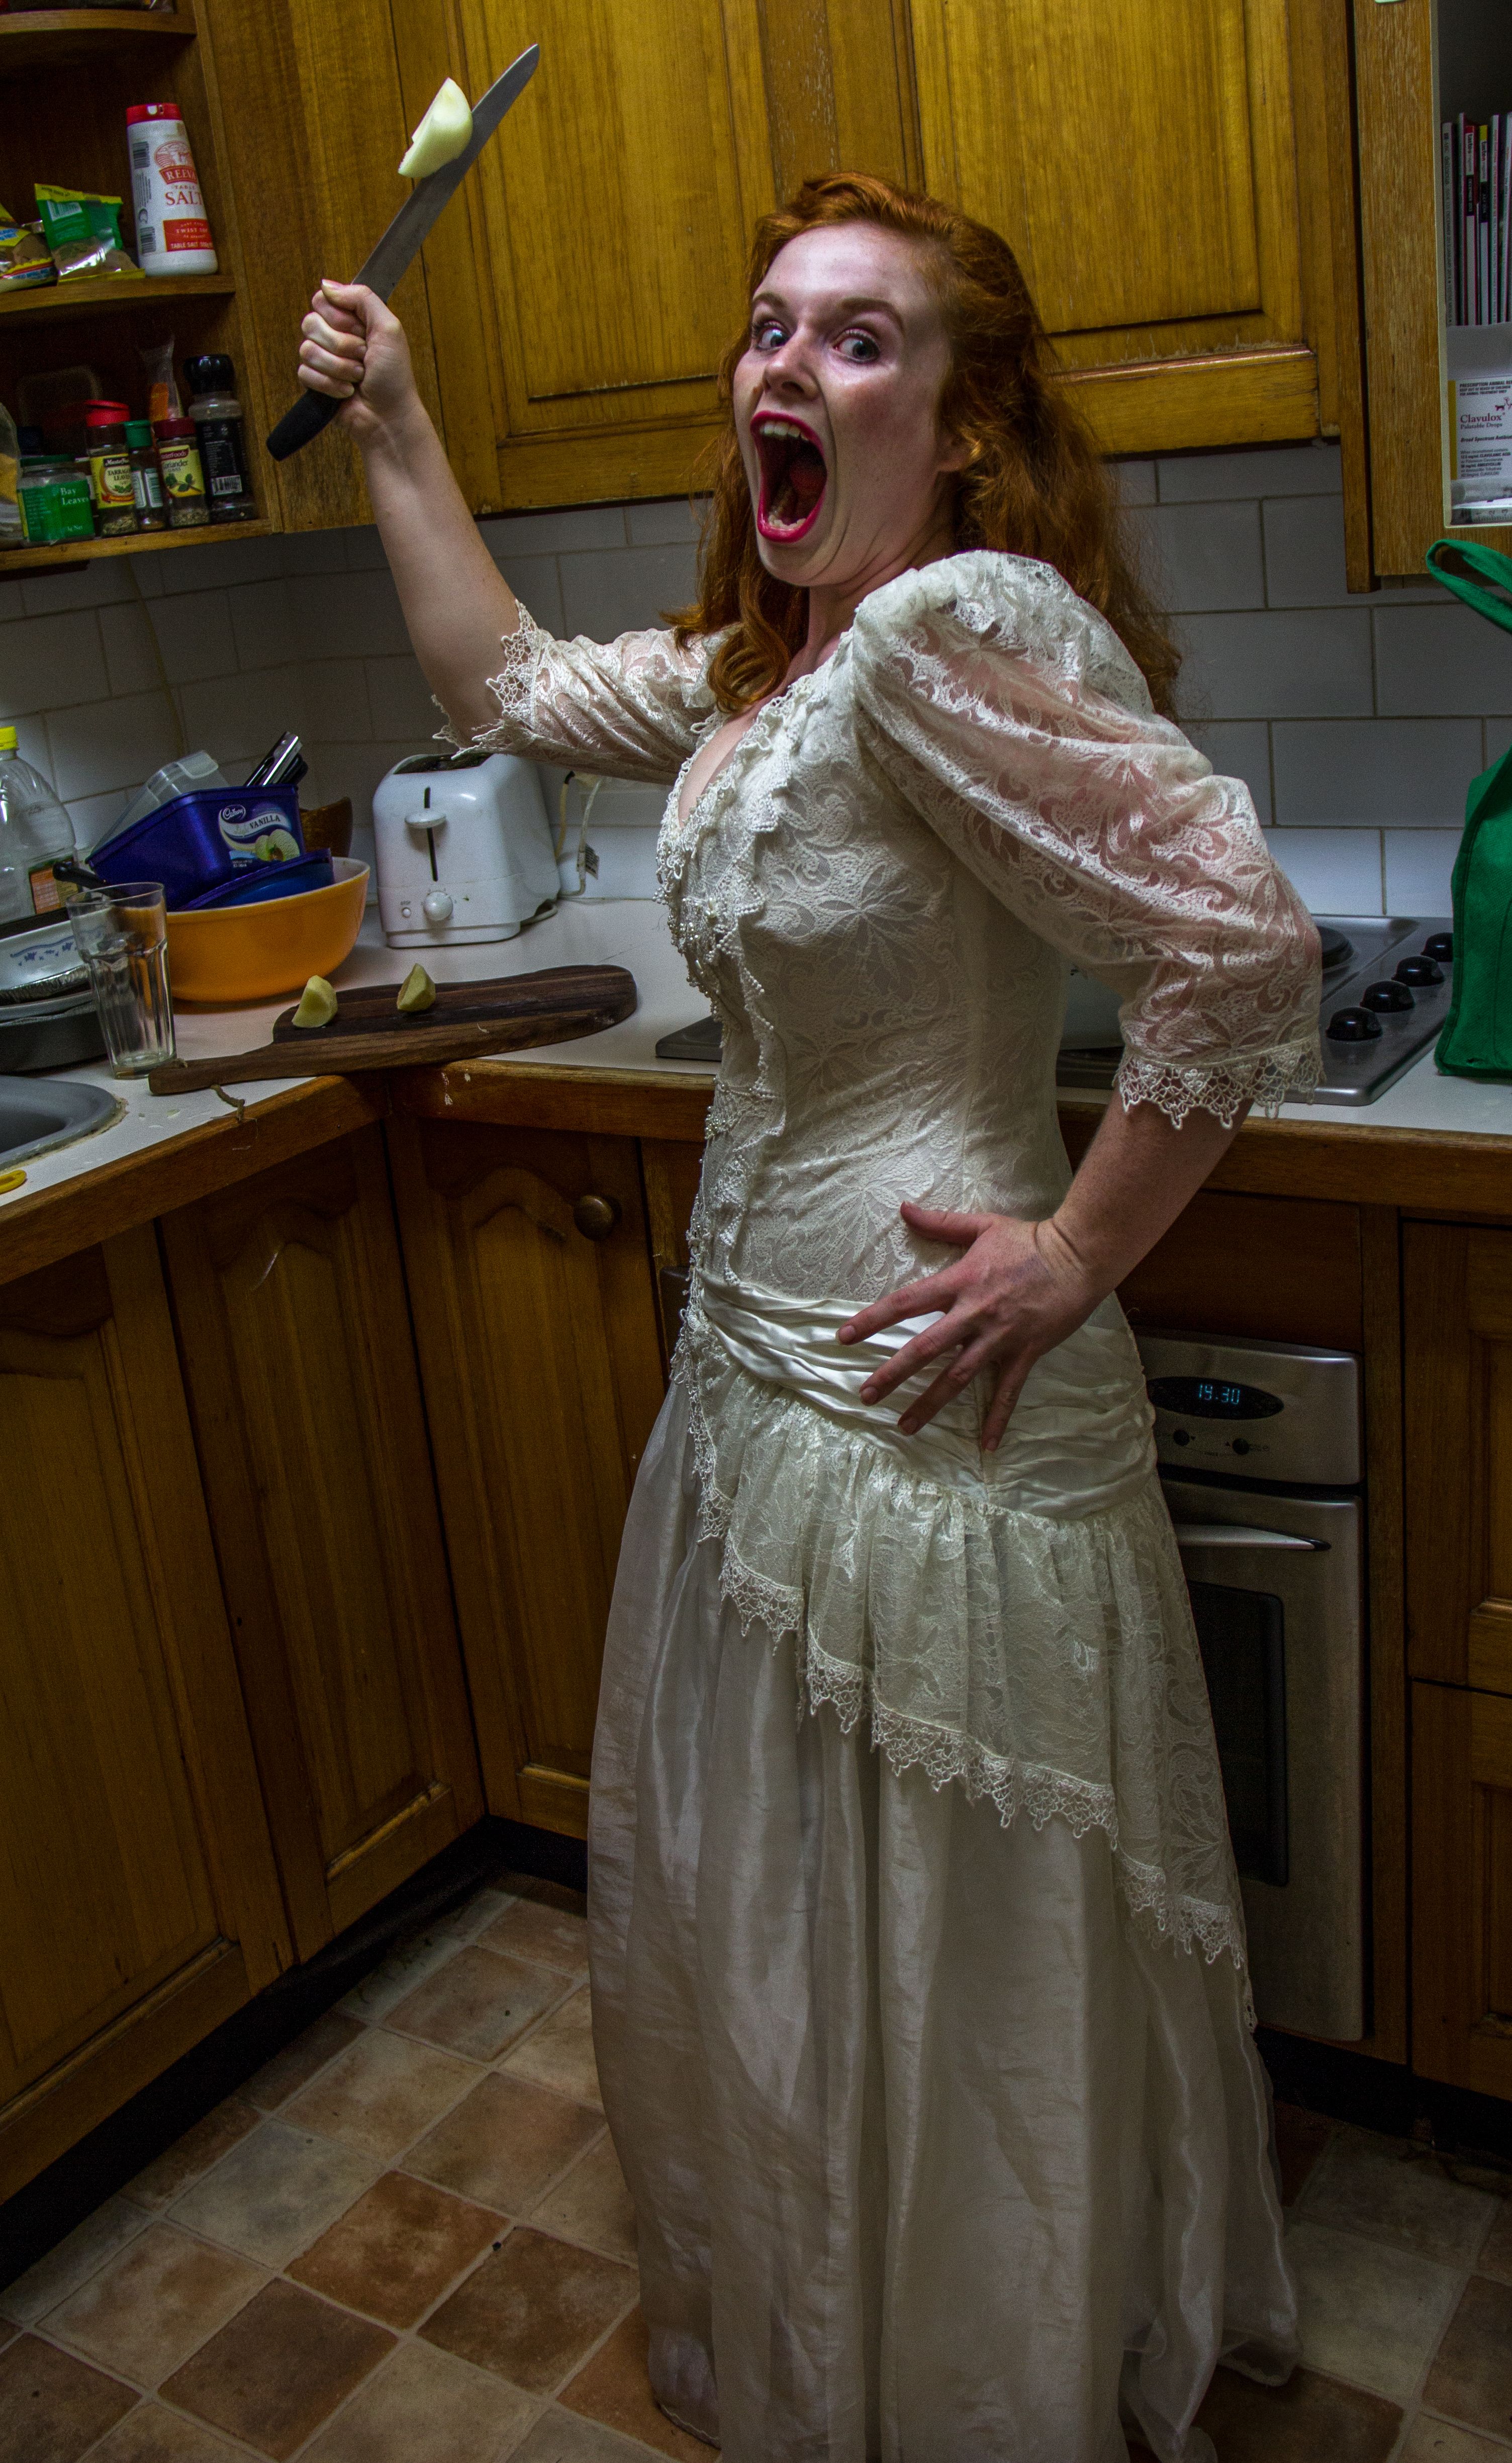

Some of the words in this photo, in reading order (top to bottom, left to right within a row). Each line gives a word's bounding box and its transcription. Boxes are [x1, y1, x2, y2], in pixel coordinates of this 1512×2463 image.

[165, 191, 202, 206] SALT
[1460, 413, 1502, 423] Clavulox
[60, 488, 76, 496] Bay
[249, 814, 281, 829] VANILLA
